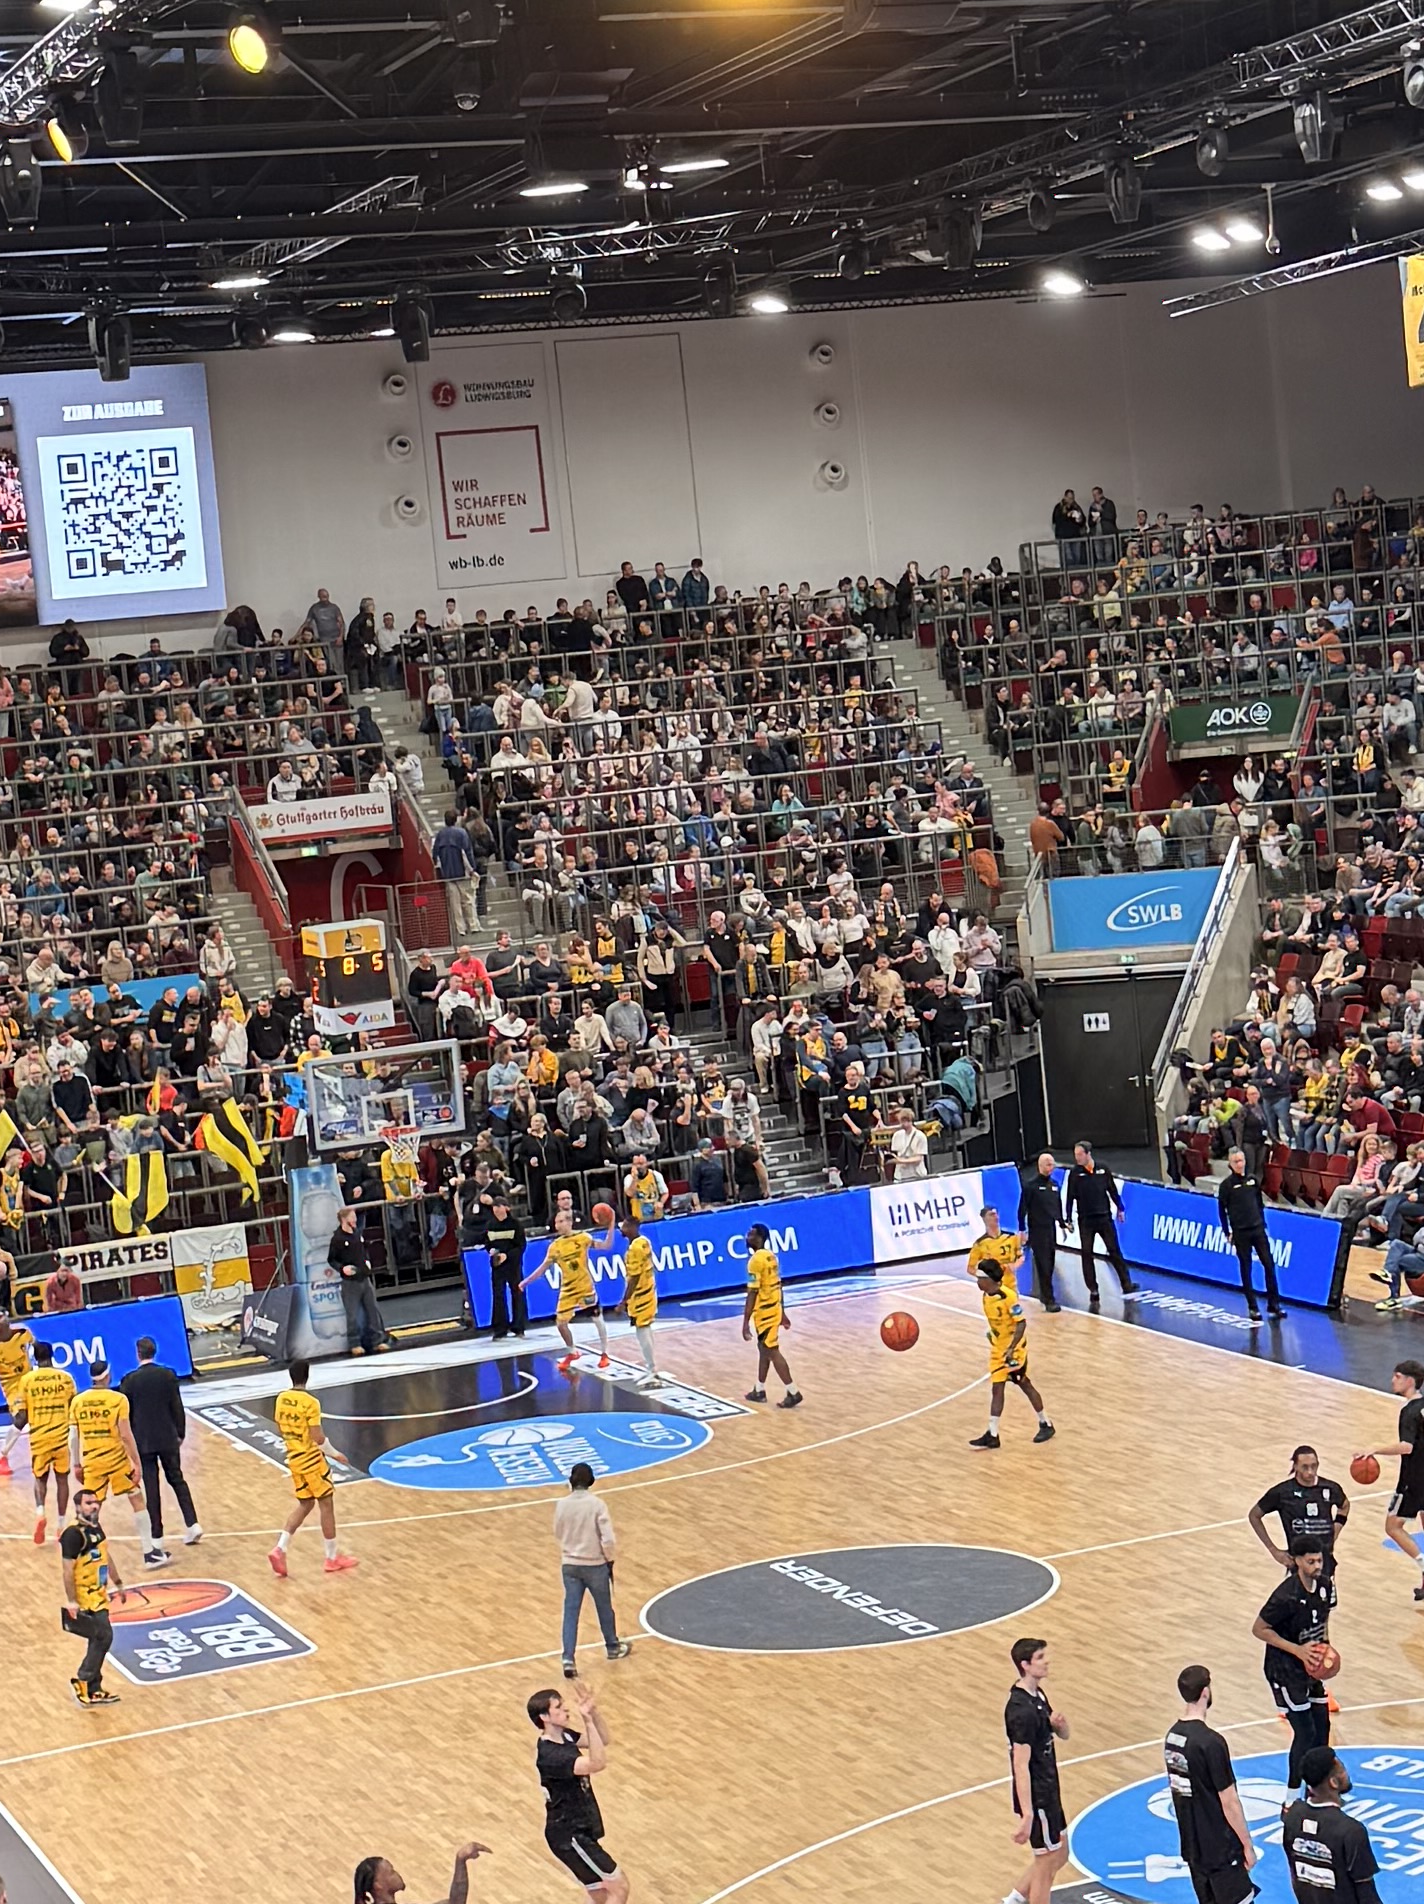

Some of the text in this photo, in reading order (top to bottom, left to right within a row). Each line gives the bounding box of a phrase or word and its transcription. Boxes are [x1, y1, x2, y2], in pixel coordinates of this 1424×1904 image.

[452, 479, 479, 493] WIR
[454, 493, 527, 511] SCHAFFEN
[456, 512, 507, 529] RÄUME
[448, 553, 505, 571] wb-lb.de
[1206, 706, 1250, 727] AOK
[276, 802, 385, 827] Stuttgarter Hofbräu
[1127, 903, 1183, 925] SWLB
[372, 952, 384, 972] 5
[913, 1195, 966, 1226] MHP
[65, 1240, 170, 1273] PIRATES
[769, 1559, 940, 1636] DEFENDER
[190, 1613, 294, 1659] BBL
